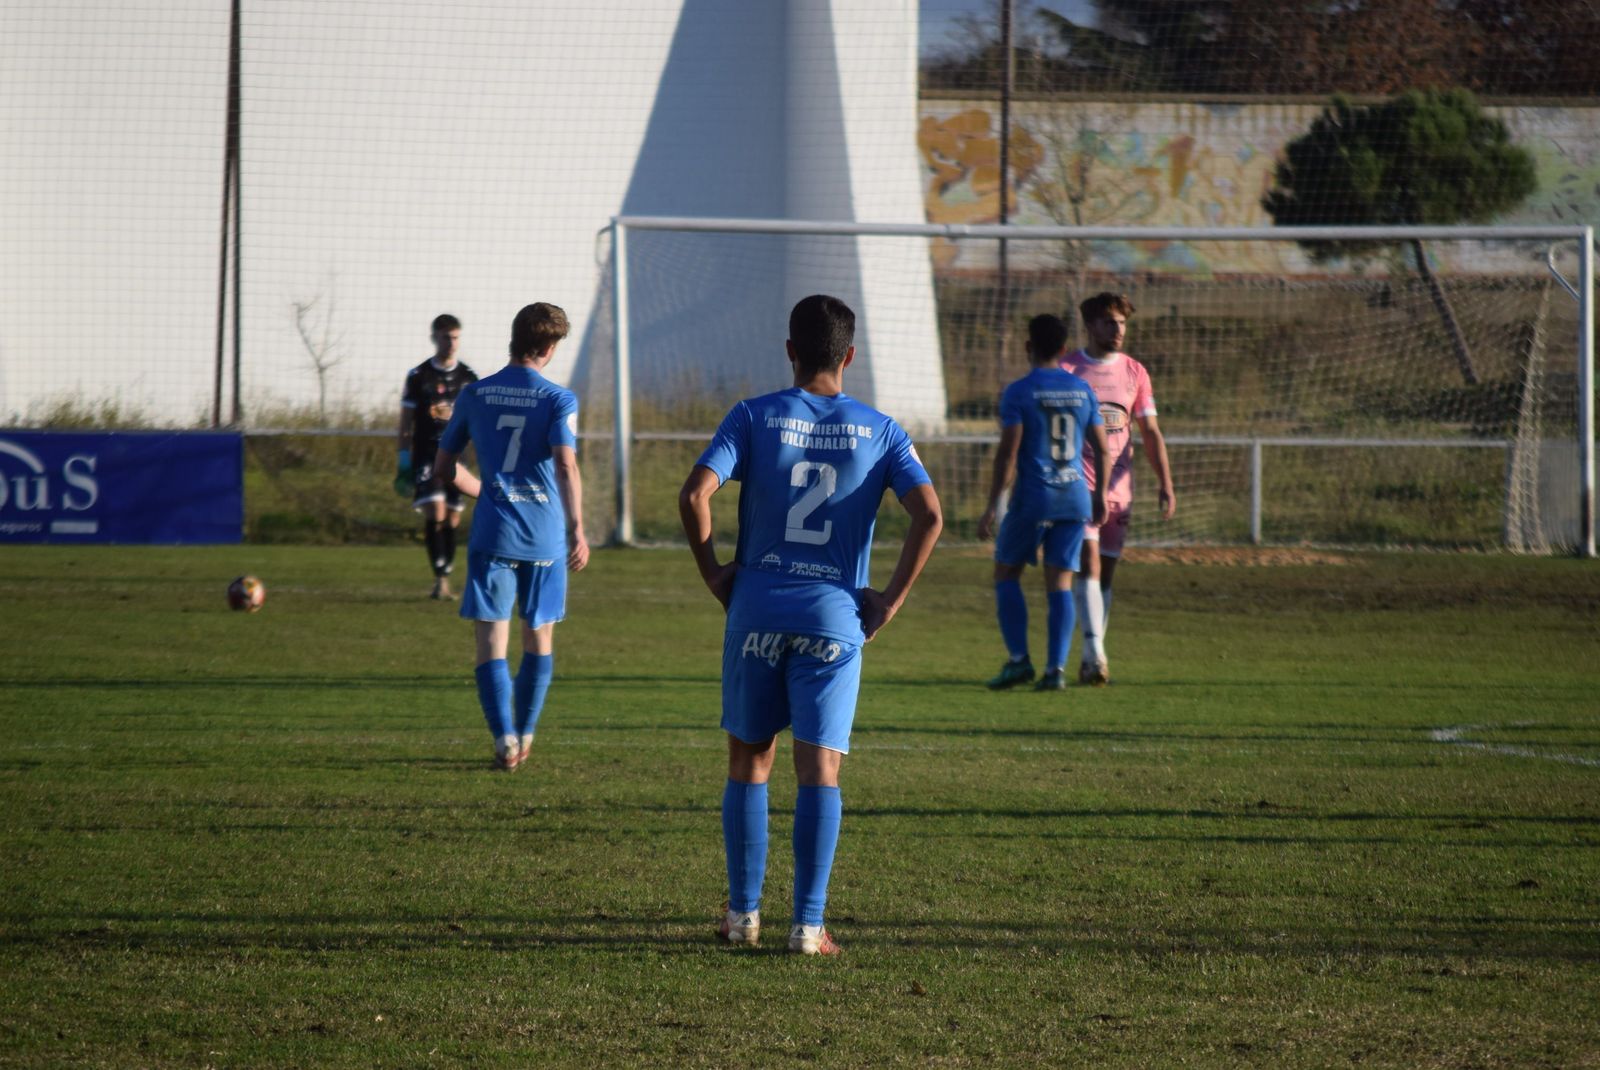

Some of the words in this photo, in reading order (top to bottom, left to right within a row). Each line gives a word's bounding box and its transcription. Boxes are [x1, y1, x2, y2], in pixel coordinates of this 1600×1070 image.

[496, 414, 527, 473] 7
[766, 416, 856, 436] AYUNTAMIENTO
[857, 425, 873, 439] DE
[780, 430, 858, 450] VILLARALBO
[1051, 413, 1076, 460] 9
[785, 461, 838, 546] 2
[742, 632, 841, 667] Alfnso
